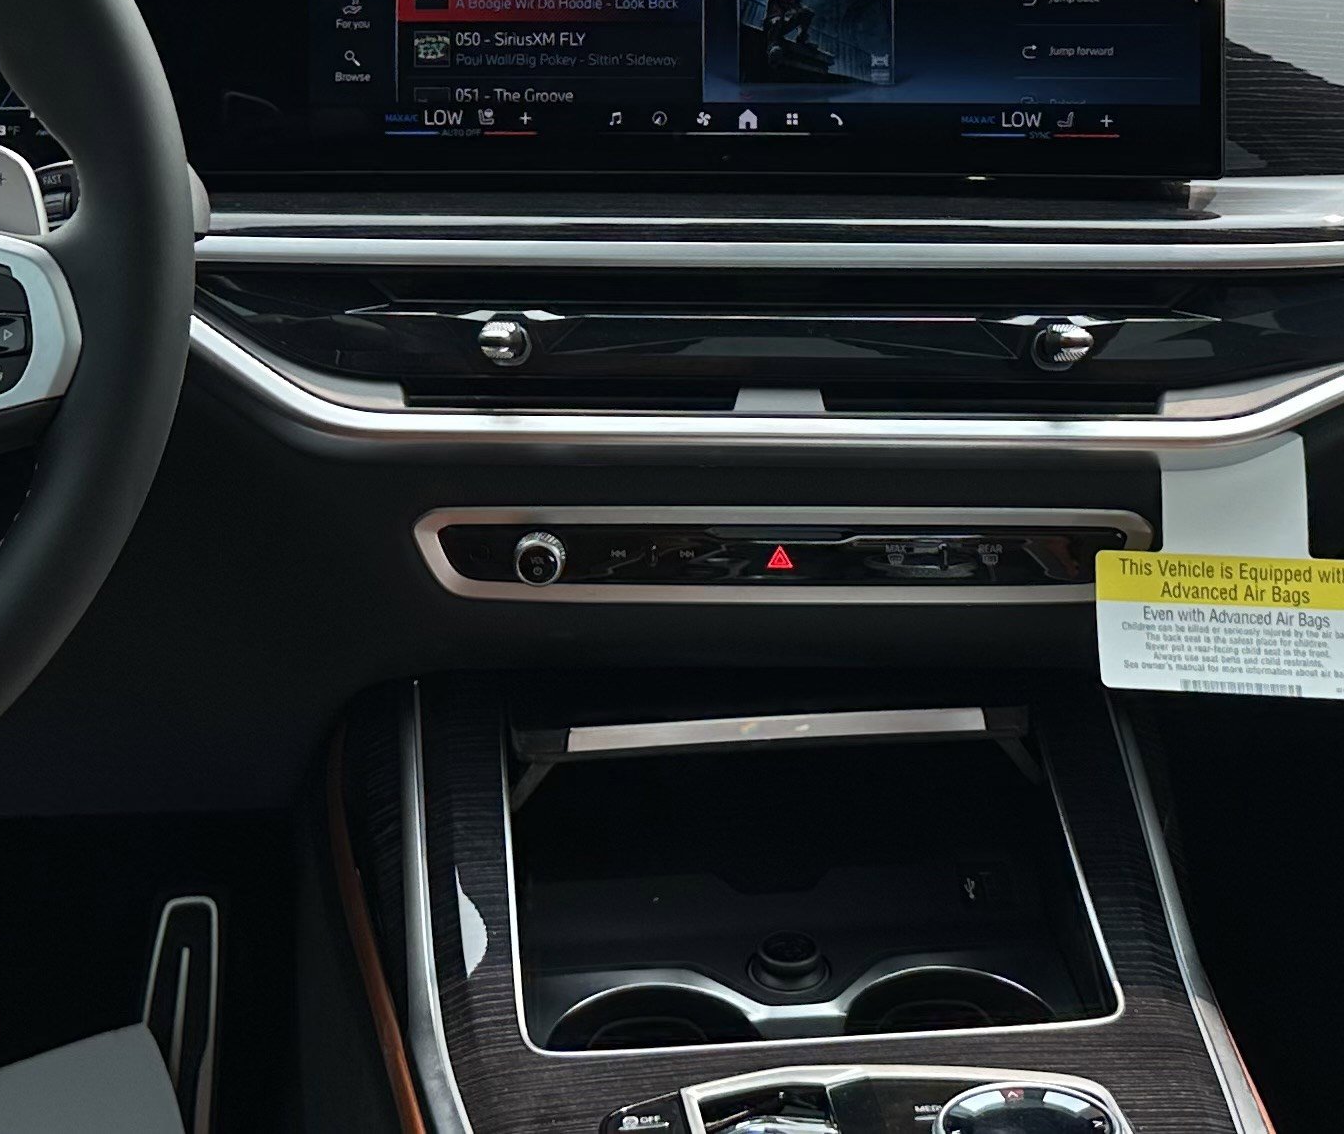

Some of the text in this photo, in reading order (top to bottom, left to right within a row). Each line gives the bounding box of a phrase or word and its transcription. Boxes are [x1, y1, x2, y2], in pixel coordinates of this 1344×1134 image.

[336, 19, 370, 31] For you
[456, 31, 586, 46] 050 SiriusXM FLY
[1049, 46, 1114, 57] Jump forward
[540, 53, 577, 68] Pokey
[334, 71, 371, 82] Browse
[456, 88, 574, 102] 051 The Groove
[424, 109, 464, 126] LOW
[1001, 111, 1043, 128] LOW
[1029, 131, 1050, 139] SYNC
[1118, 557, 1153, 576] This
[1157, 559, 1215, 579] Vehicle
[1220, 562, 1233, 580] is
[1239, 562, 1313, 585] Equipped
[1160, 581, 1311, 606] Advanced Air Bags
[1142, 605, 1331, 630] Even with Advanced Air Bags
